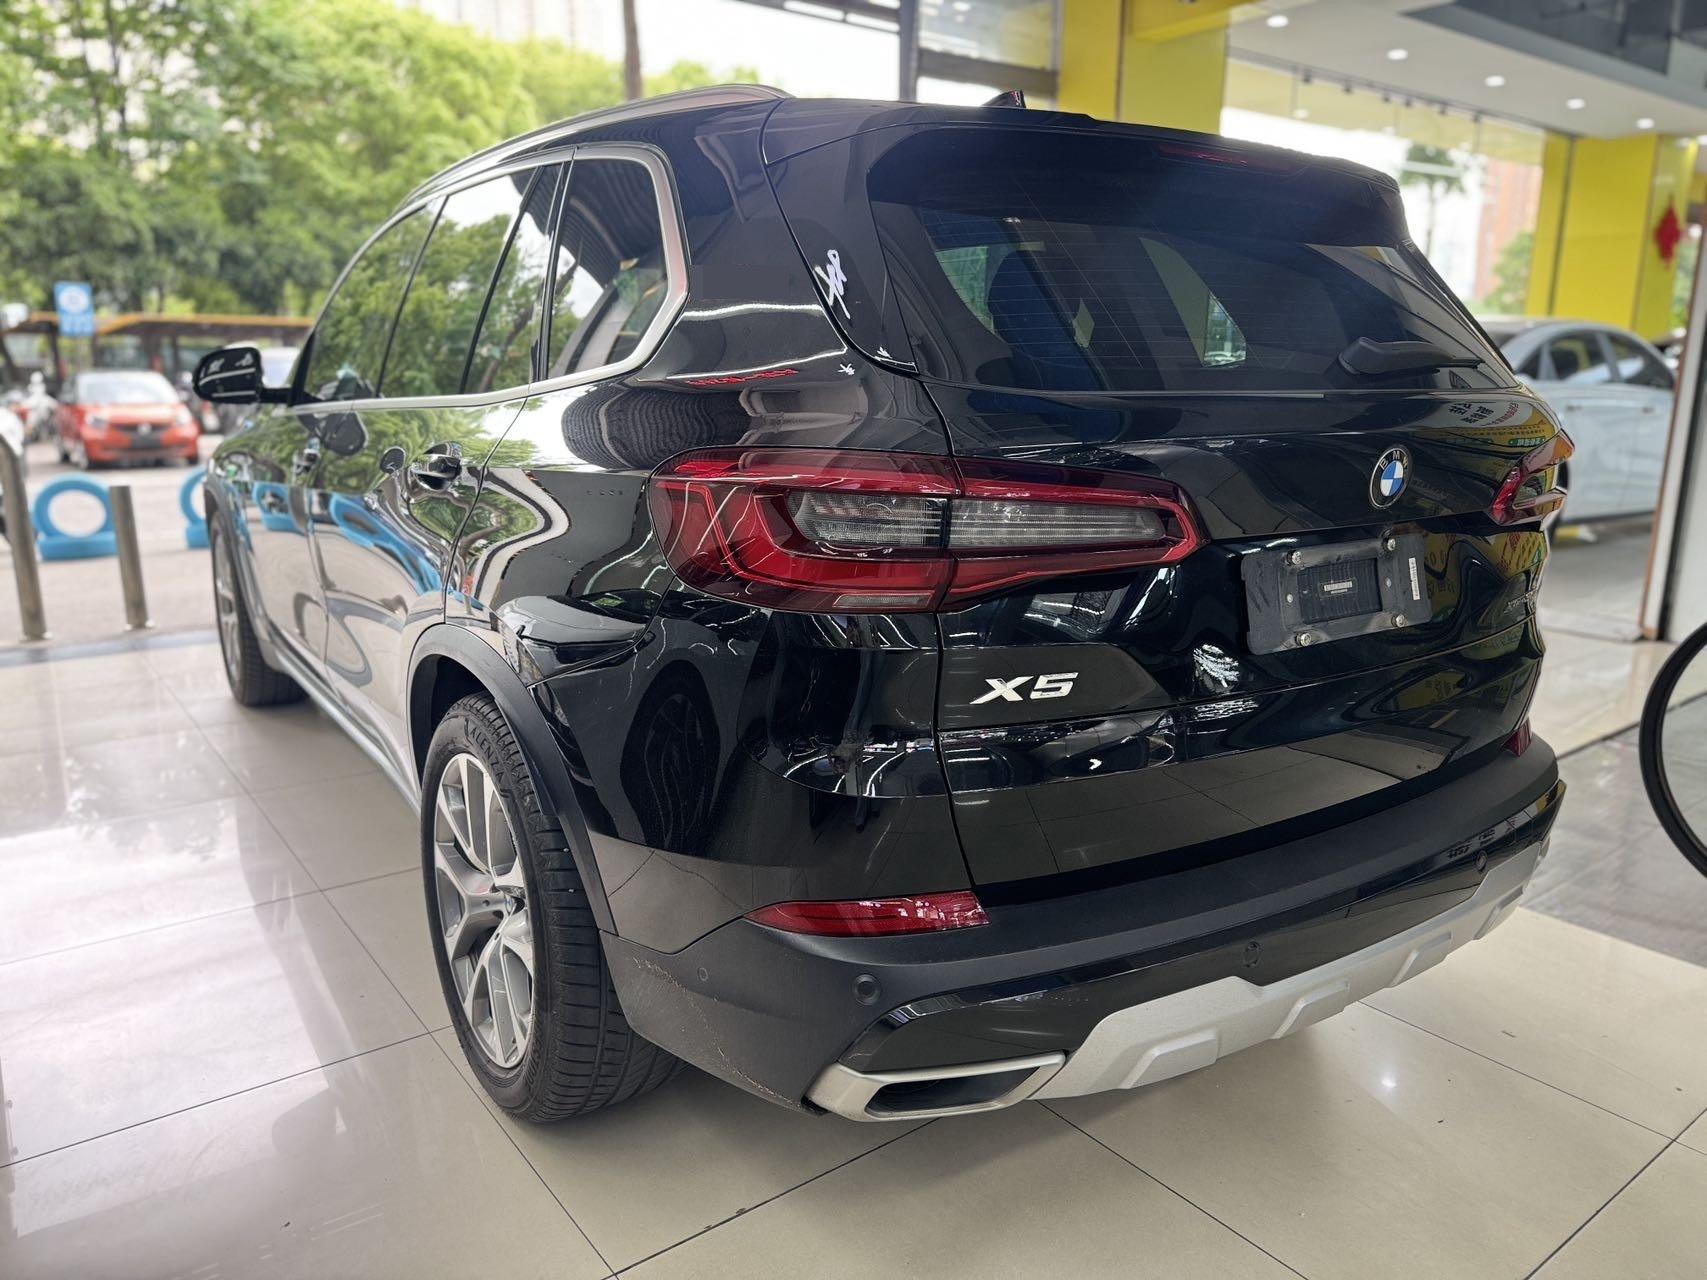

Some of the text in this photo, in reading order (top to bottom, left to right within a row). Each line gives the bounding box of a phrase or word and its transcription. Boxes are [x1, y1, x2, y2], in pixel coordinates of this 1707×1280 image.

[1379, 450, 1409, 470] BMW
[969, 672, 1079, 705] X5
[469, 726, 505, 783] ALENZA
